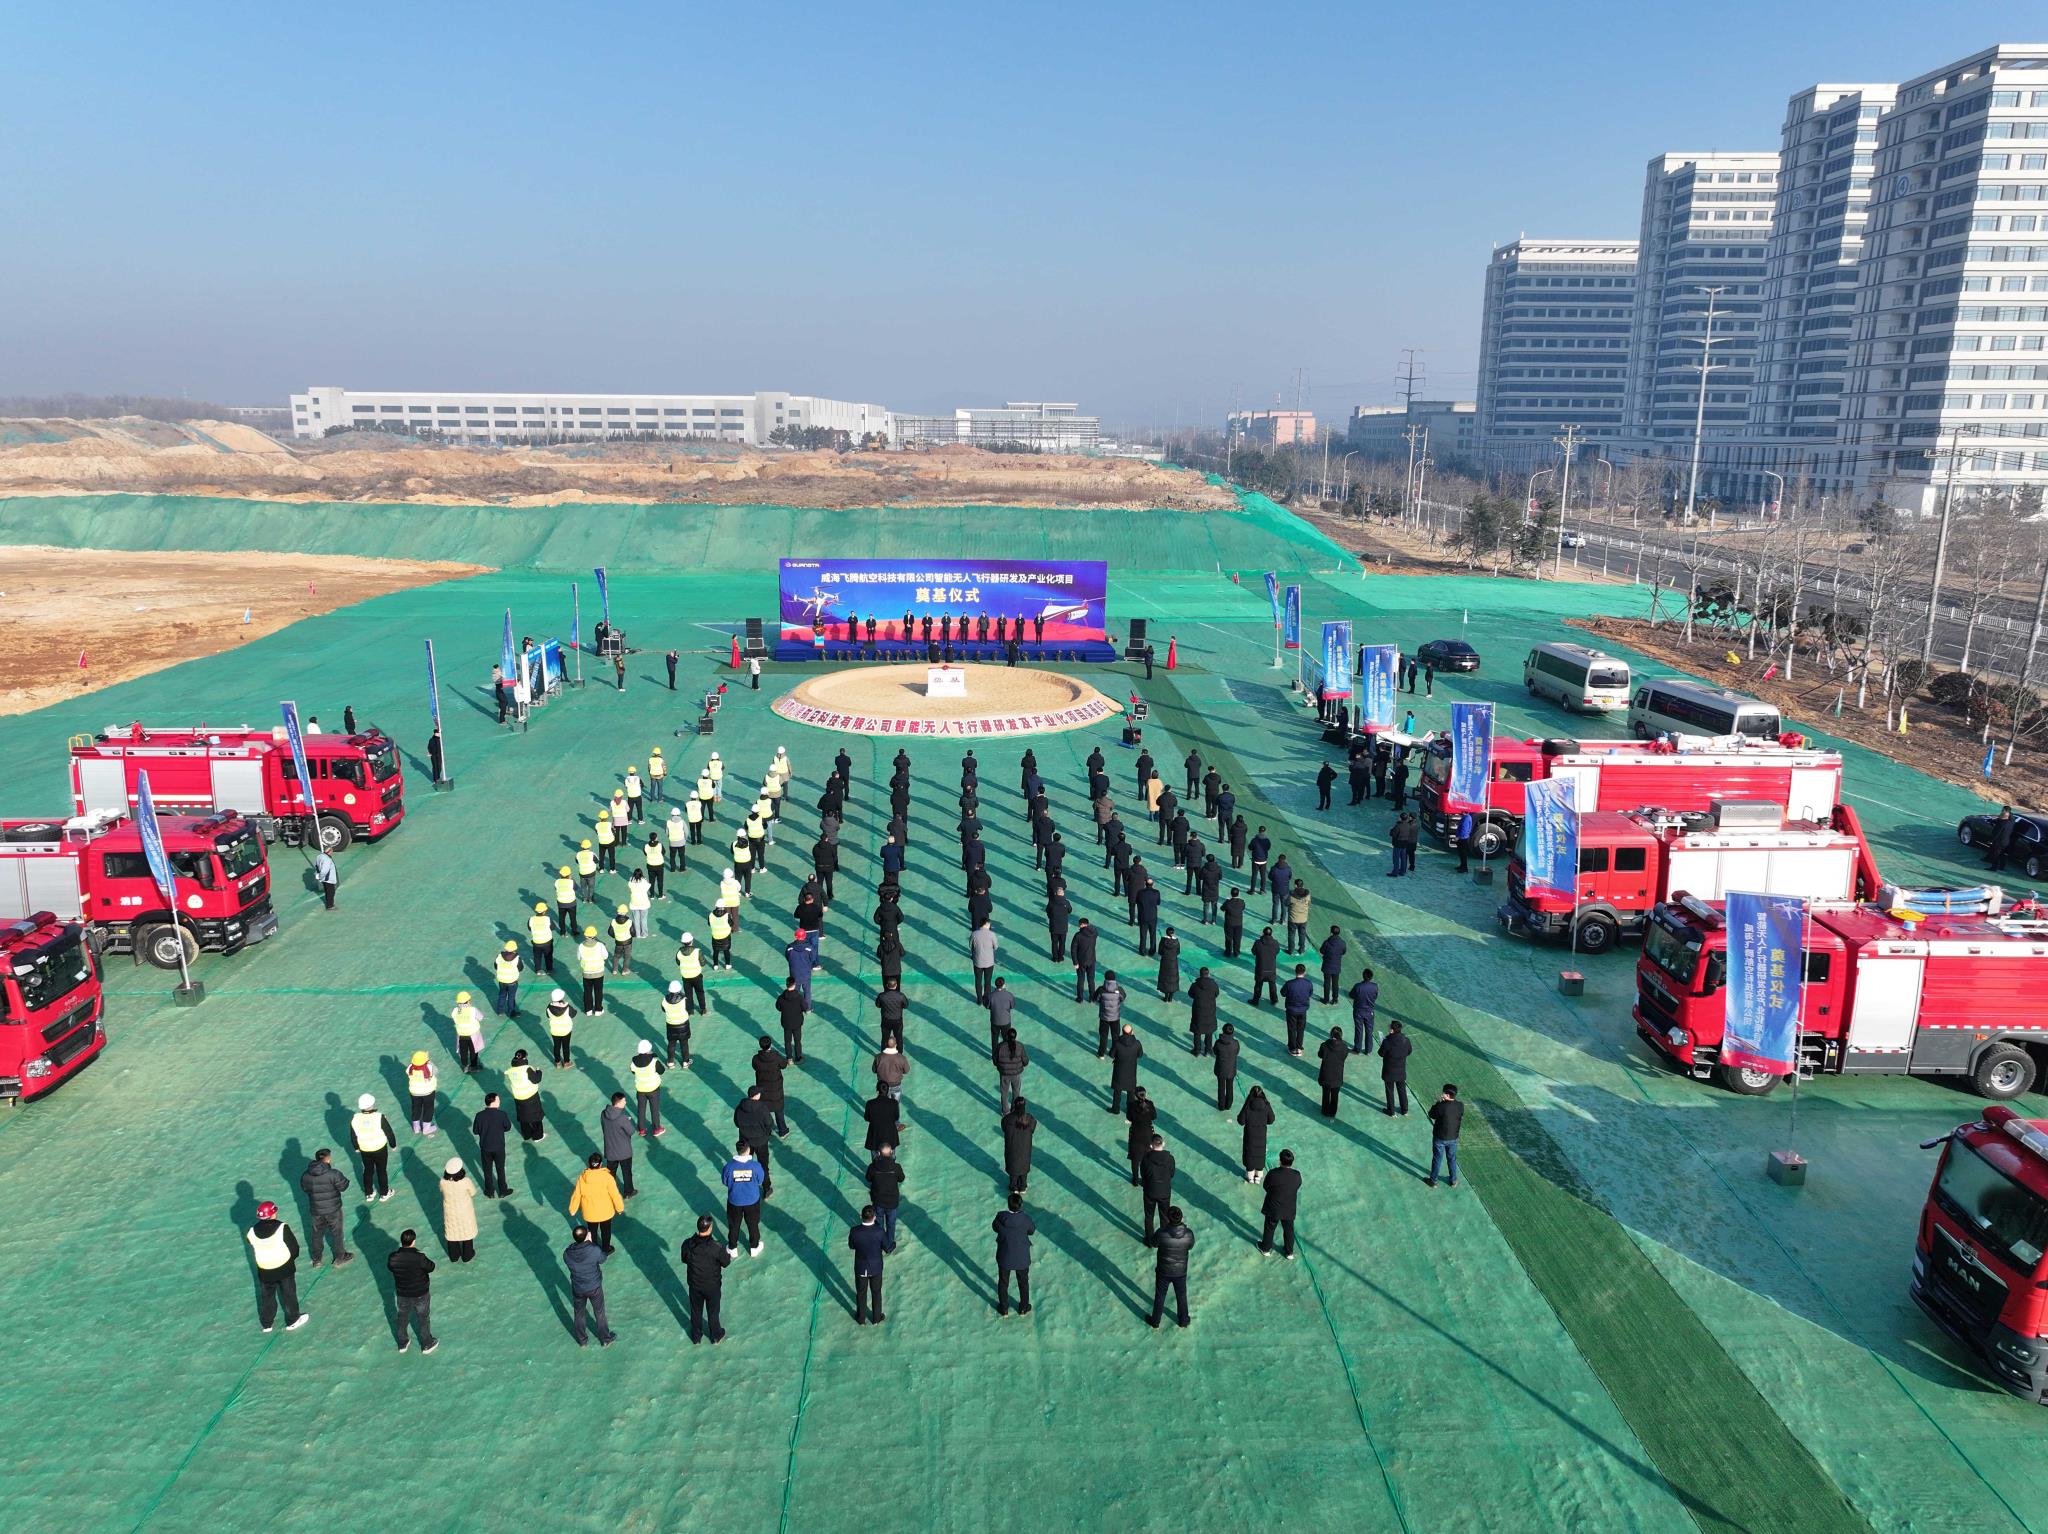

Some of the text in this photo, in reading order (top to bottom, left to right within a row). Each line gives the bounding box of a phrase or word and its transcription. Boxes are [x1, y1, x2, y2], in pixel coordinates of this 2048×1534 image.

[821, 572, 1073, 584] 威海飞腾航空科技有限公司智能无人飞行器研发及产业化项目
[915, 587, 980, 603] 奠基仪式
[1947, 1257, 1980, 1292] MAN
